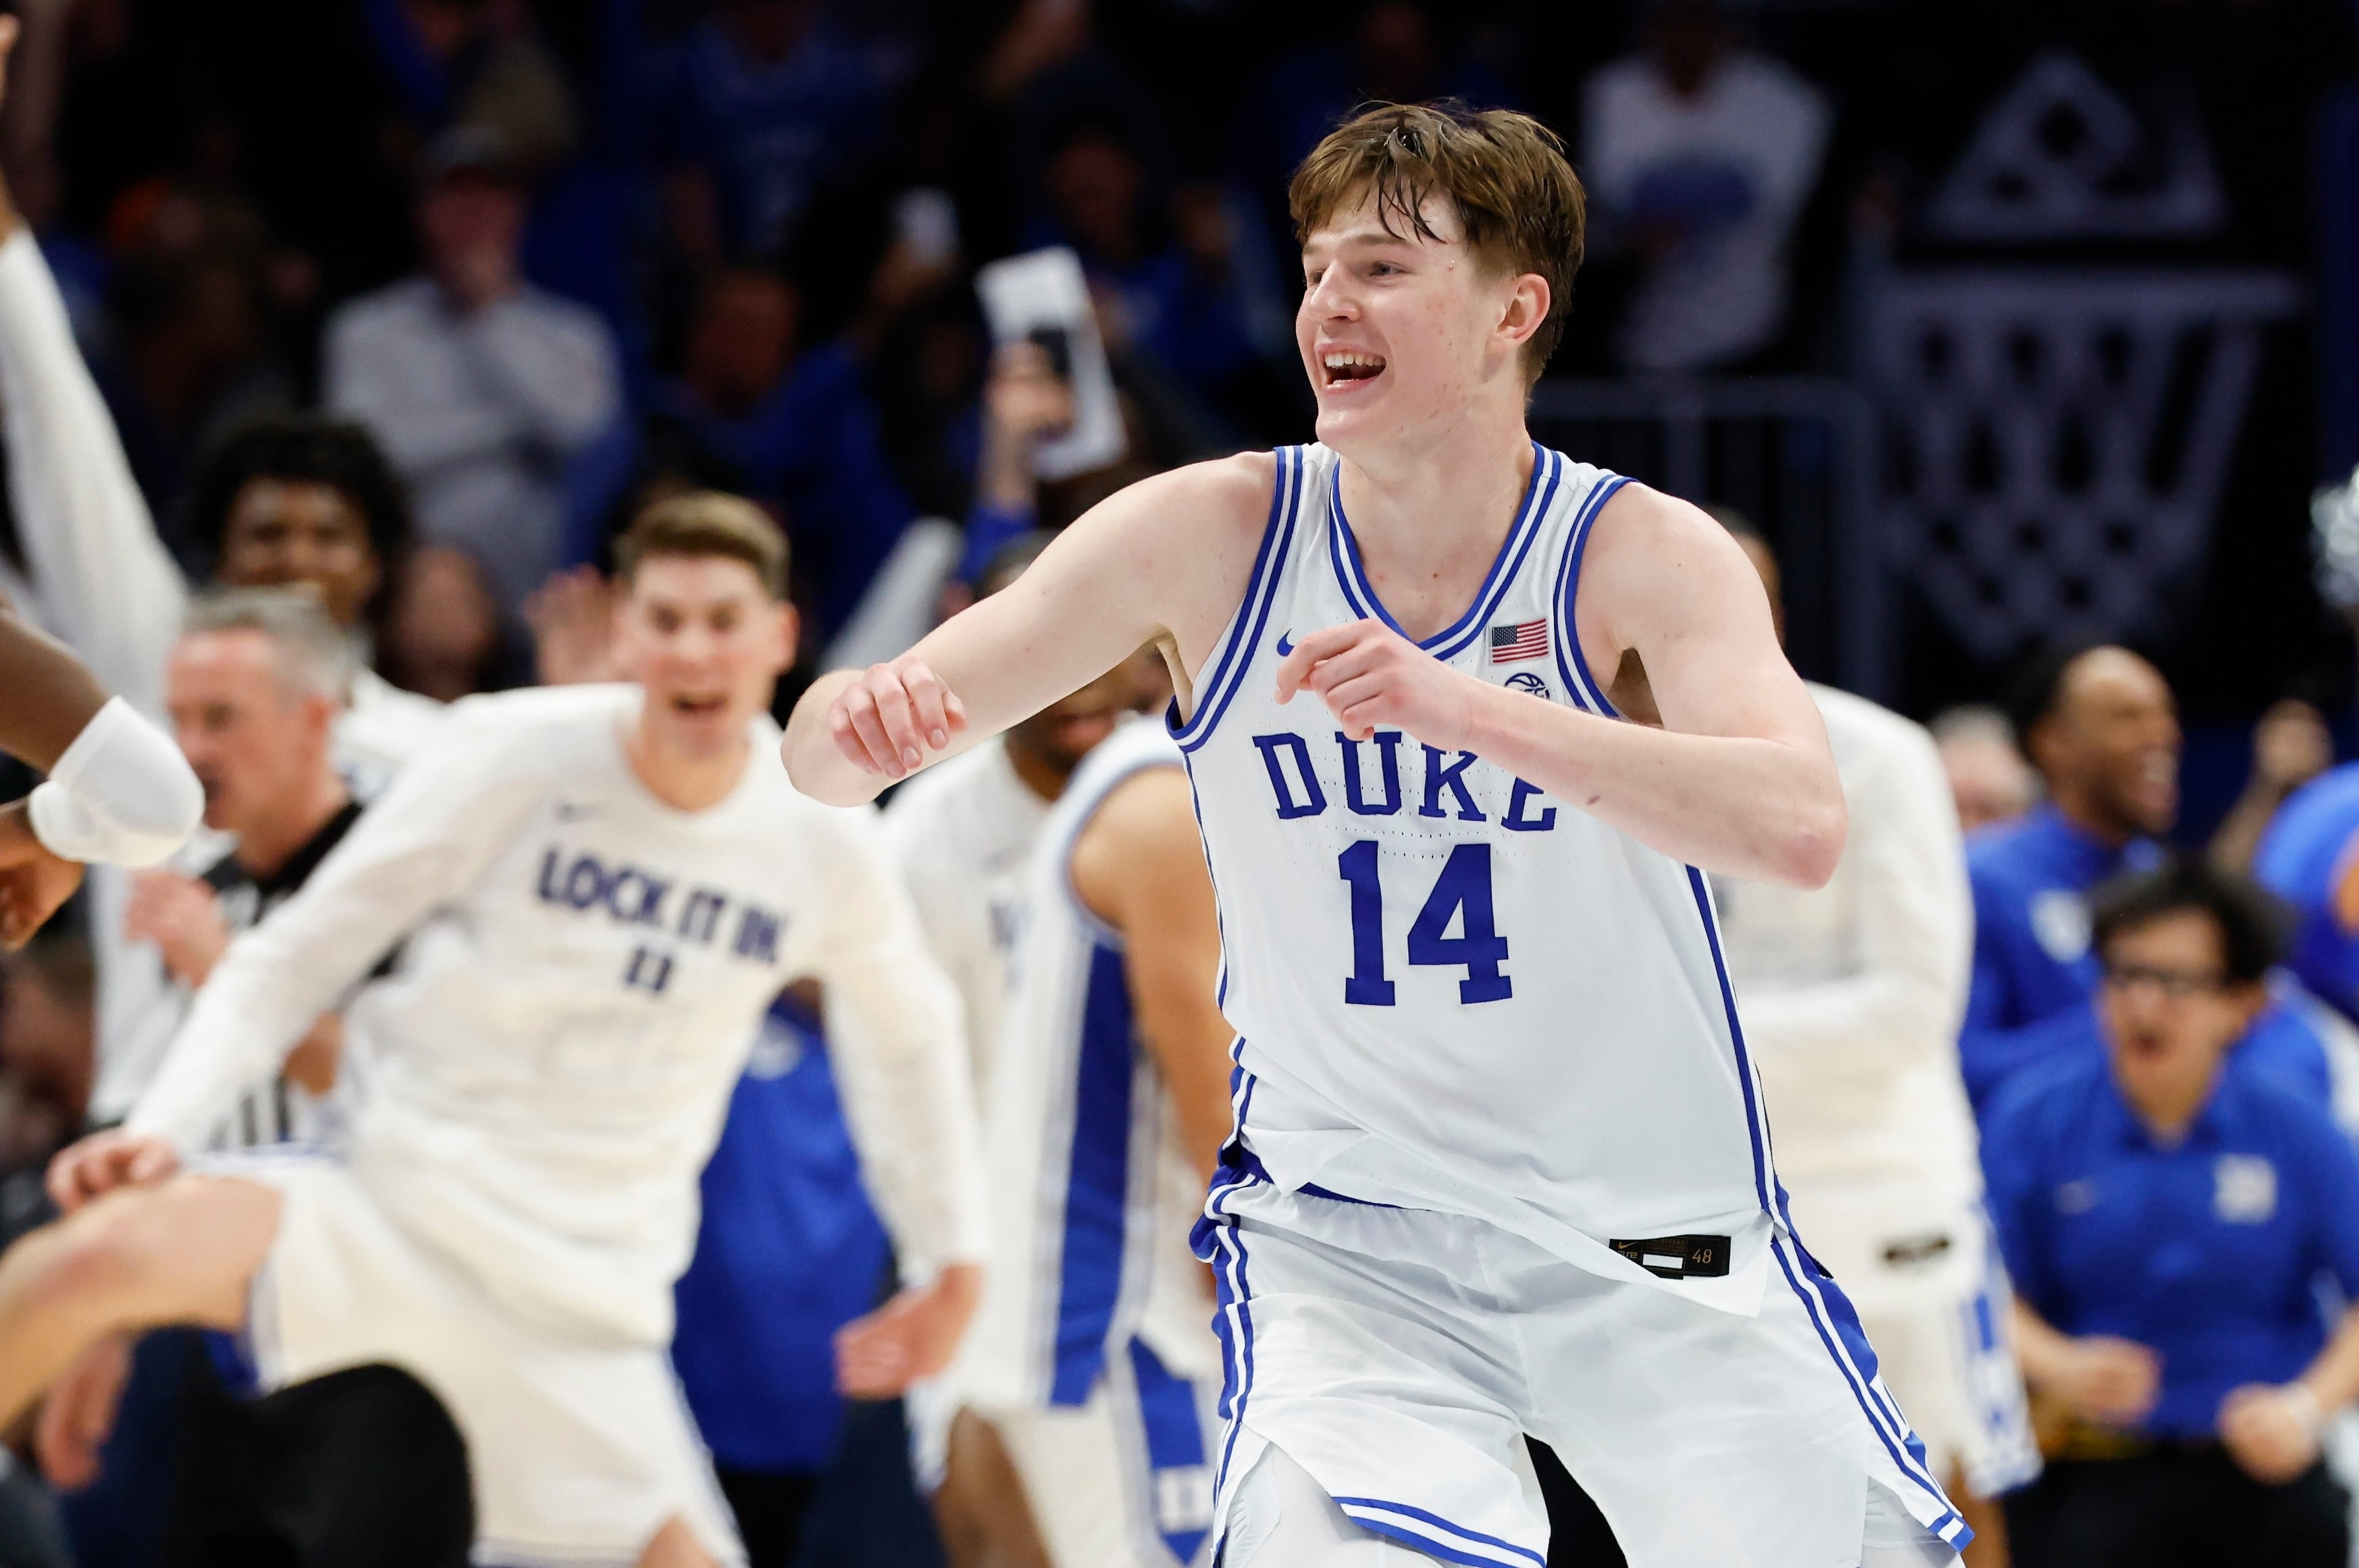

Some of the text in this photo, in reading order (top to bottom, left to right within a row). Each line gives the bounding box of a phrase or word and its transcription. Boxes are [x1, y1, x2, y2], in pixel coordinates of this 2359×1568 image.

[1252, 732, 1557, 832] DUKE
[1338, 840, 1512, 1006] 14
[1692, 1249, 1713, 1264] 48
